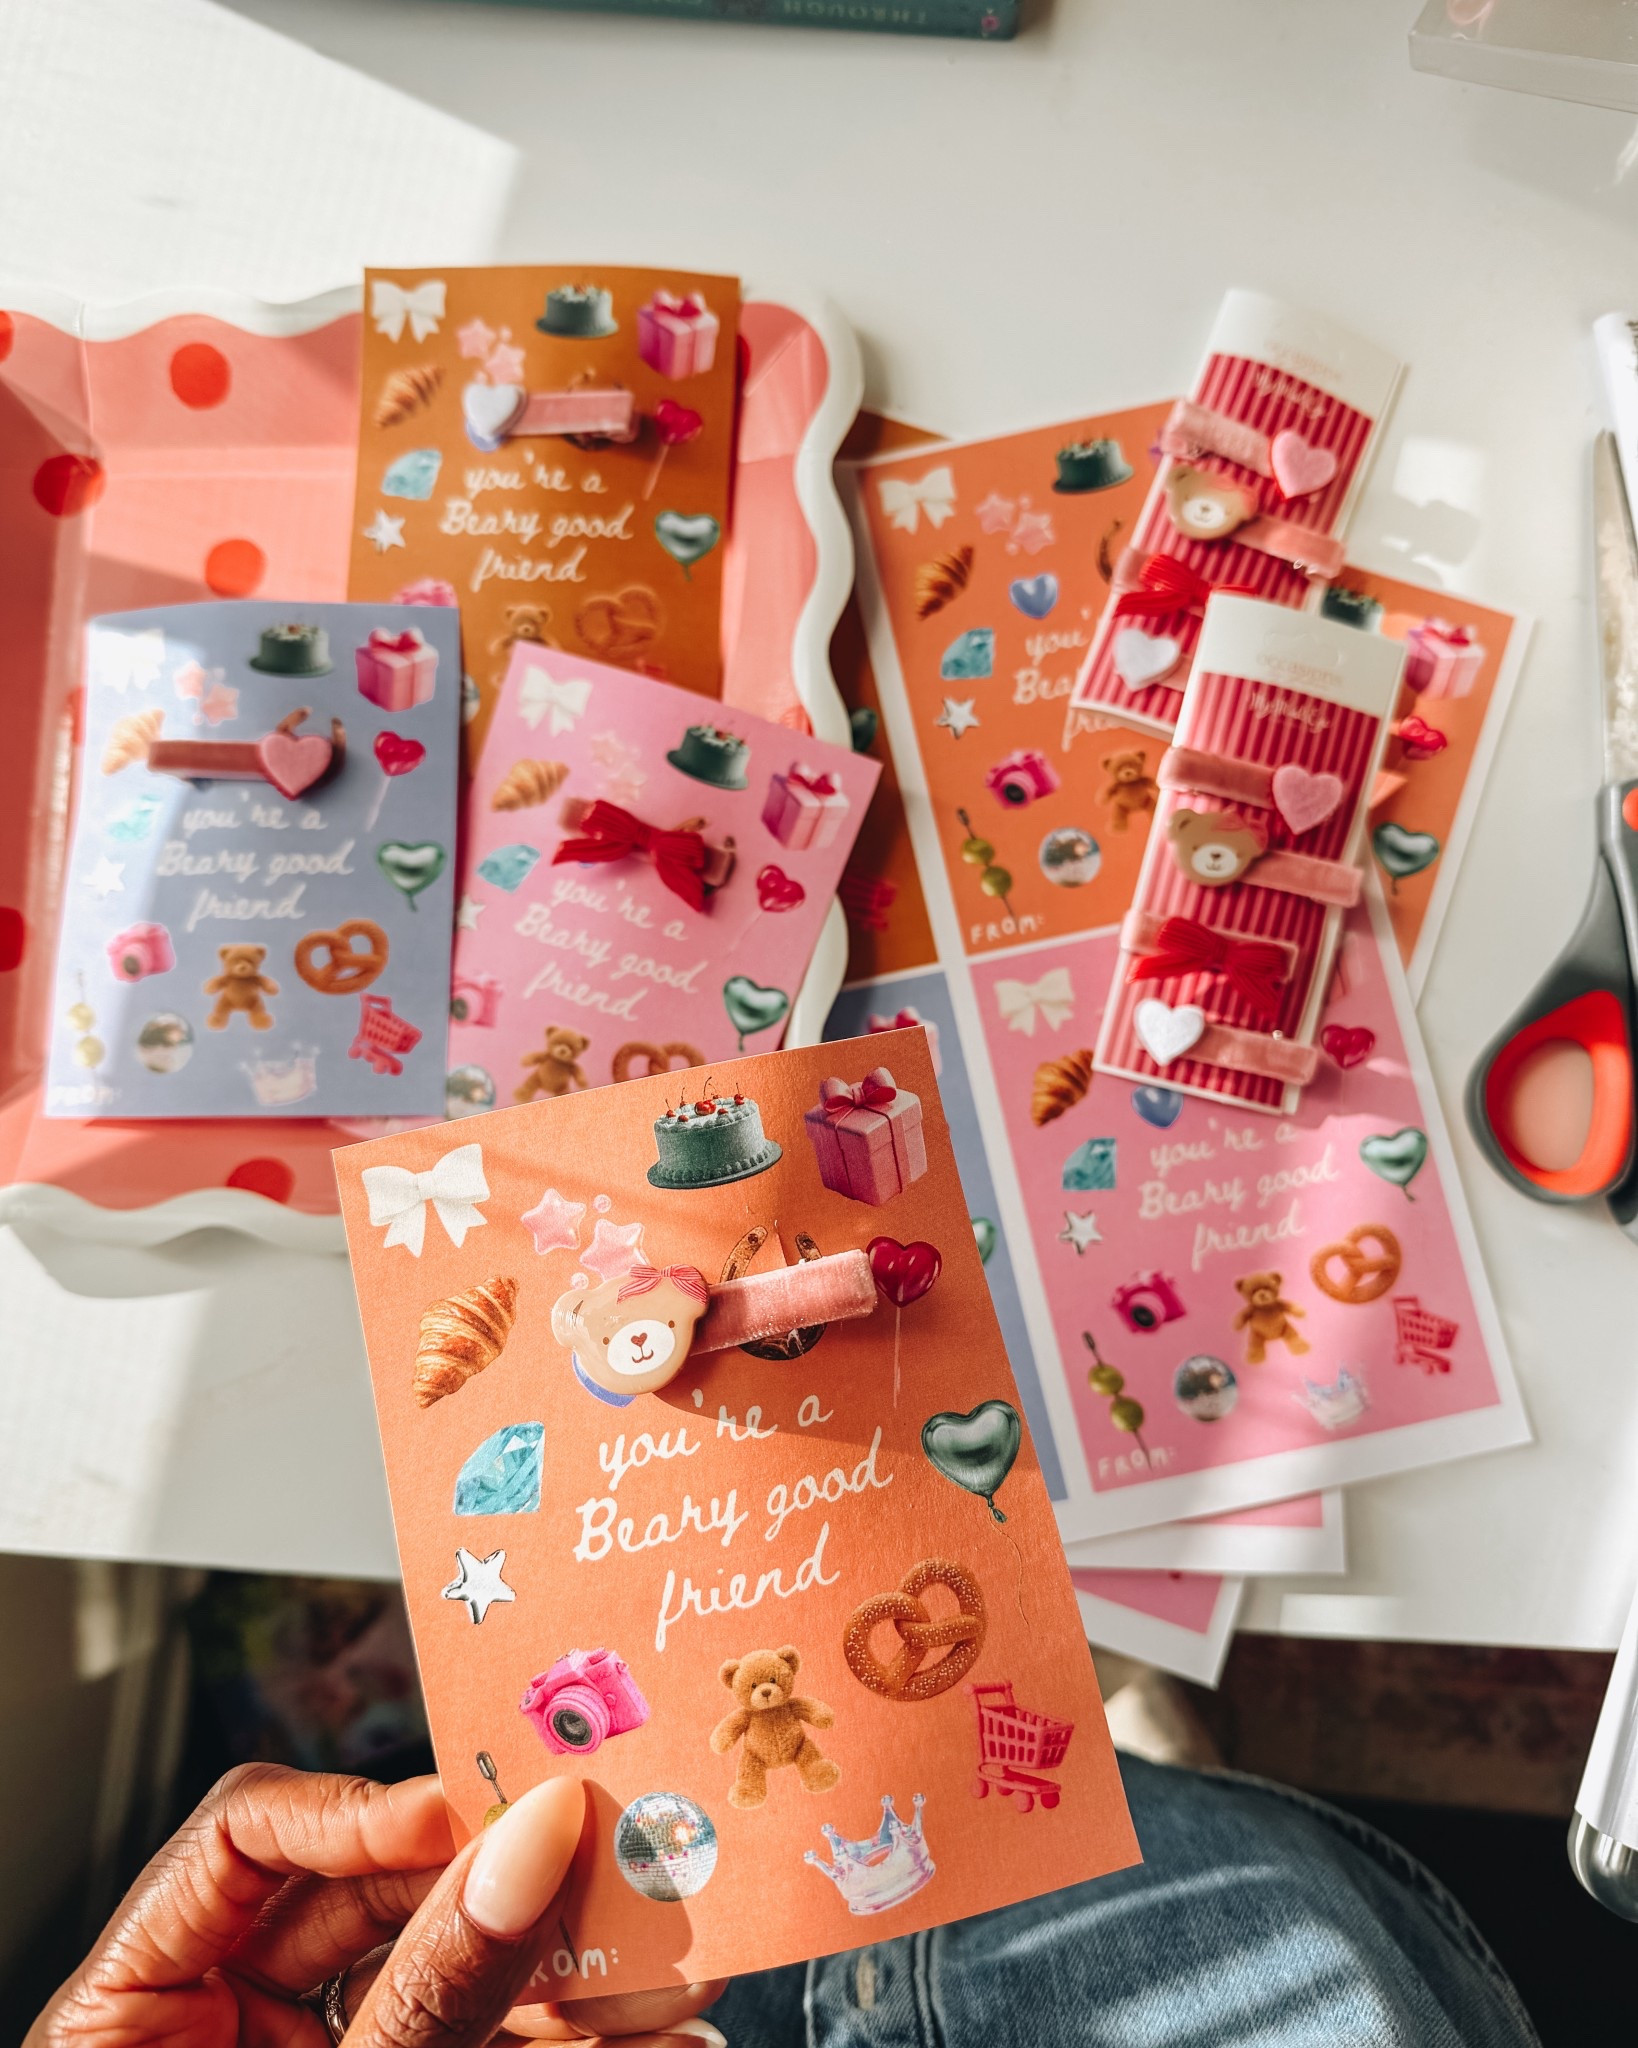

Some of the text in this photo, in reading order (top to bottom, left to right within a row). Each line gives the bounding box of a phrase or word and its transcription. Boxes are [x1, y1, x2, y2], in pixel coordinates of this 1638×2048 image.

[463, 449, 608, 498] you're a
[438, 498, 636, 549] Beary good
[469, 547, 587, 593] friend
[1012, 667, 1079, 705] Bea
[182, 789, 328, 838] you're a
[154, 838, 356, 887] Beary good
[186, 882, 307, 934] friend
[550, 878, 689, 942] you're a
[513, 902, 710, 995] Beary good
[522, 960, 649, 1022] friend
[1150, 1116, 1300, 1179] you're a
[1138, 1141, 1341, 1221] Beary good
[1191, 1197, 1305, 1272] friend
[598, 1388, 835, 1492] you're a
[572, 1425, 895, 1563] Beary good
[654, 1520, 841, 1653] friend
